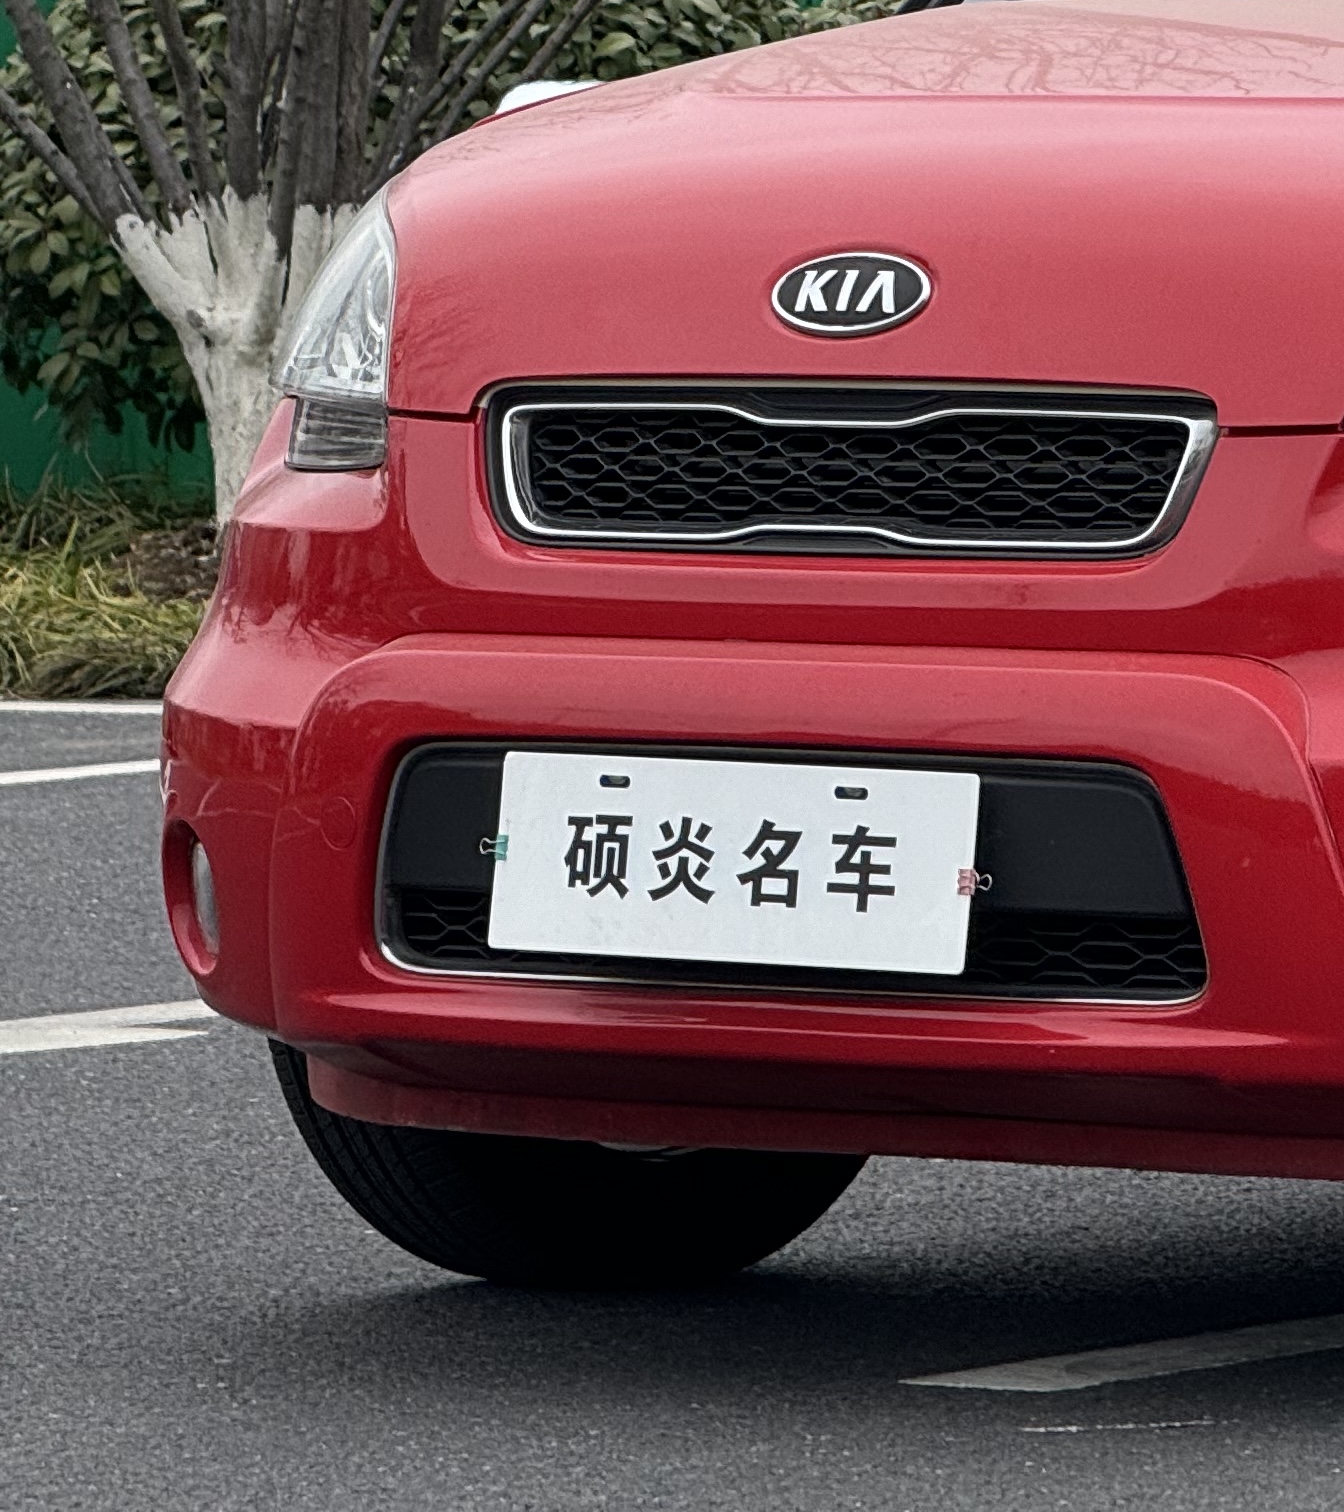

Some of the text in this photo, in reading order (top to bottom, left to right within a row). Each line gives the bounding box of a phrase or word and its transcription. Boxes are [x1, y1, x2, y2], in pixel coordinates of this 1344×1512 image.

[794, 269, 895, 314] KIA
[563, 813, 898, 913] 硕炎名车
